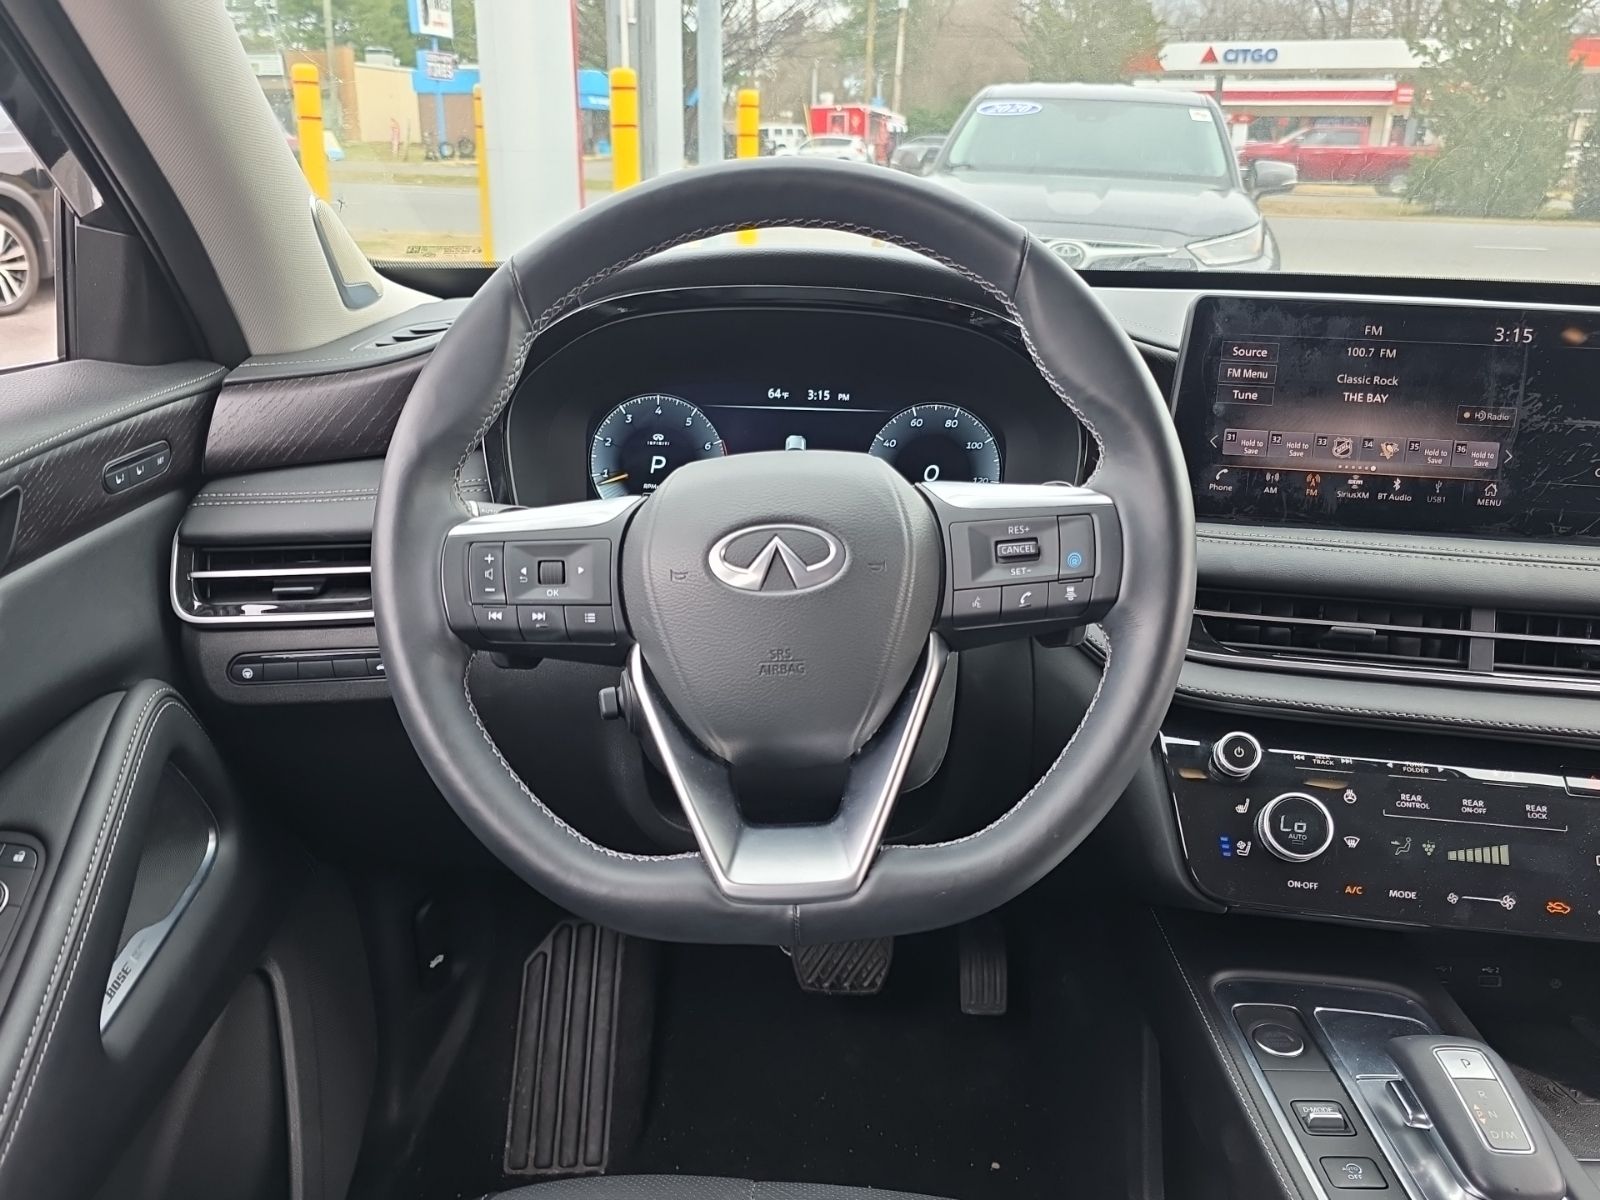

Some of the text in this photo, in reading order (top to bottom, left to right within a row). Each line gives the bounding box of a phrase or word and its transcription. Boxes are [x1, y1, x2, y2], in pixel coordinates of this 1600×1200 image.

[1223, 48, 1278, 63] CITGO
[1364, 326, 1383, 336] FM
[1494, 327, 1534, 343] 3:15
[1232, 346, 1268, 358] Source
[1347, 347, 1397, 359] 100.7 FM
[1227, 368, 1269, 380] FM Menu
[1336, 374, 1399, 386] Classic Rock
[807, 389, 850, 401] 3:15 PM
[1232, 390, 1258, 401] Tune
[1343, 392, 1389, 404] THE BAY
[655, 406, 662, 415] 4
[625, 414, 632, 423] 3
[685, 417, 693, 426] 5
[1487, 413, 1510, 422] Radio
[910, 418, 923, 428] 60
[944, 419, 958, 428] 80
[604, 437, 612, 446] 2
[1226, 433, 1236, 441] 31
[1271, 435, 1281, 443] 32
[1317, 437, 1327, 446] 33
[704, 442, 712, 451] 6
[883, 438, 897, 448] 40
[966, 442, 984, 450] 100
[1241, 439, 1255, 447] Hold
[1363, 440, 1373, 448] 34
[1409, 442, 1420, 451] 35
[1244, 447, 1259, 455] Save
[1288, 449, 1304, 457] Save
[1424, 448, 1448, 457] Hold to
[1456, 445, 1466, 453] 36
[1471, 451, 1486, 459] Hold
[650, 455, 666, 474] P
[1427, 456, 1443, 464] Save
[1473, 459, 1489, 467] Save
[602, 468, 609, 477] 1
[1208, 483, 1233, 492] Phone
[1336, 490, 1370, 499] SiriusXM
[1377, 492, 1412, 502] BT Audio
[1426, 495, 1446, 503] USB1
[1476, 498, 1502, 507] MENU
[1008, 526, 1030, 535] RES+
[1001, 544, 1036, 555] CANCEL
[546, 589, 560, 597] OK
[769, 648, 792, 661] SRS
[758, 663, 806, 677] AIRBAG
[1312, 758, 1335, 766] TRACK
[1402, 766, 1429, 774] FOLDER
[1400, 793, 1422, 802] REAR
[1396, 801, 1430, 810] CONTROL
[1462, 799, 1484, 808] REAR
[1461, 806, 1487, 815] ON-OFF
[1525, 804, 1548, 813] REAR
[1527, 812, 1548, 820] LOCK
[1280, 814, 1307, 833] Lo
[1288, 833, 1308, 841] AUTO
[1287, 879, 1319, 890] ON-OFF
[1345, 885, 1363, 895] A/C
[1388, 889, 1417, 900] MODE
[105, 961, 132, 1005] BOSE
[1460, 1058, 1471, 1069] P
[1477, 1090, 1487, 1098] R
[1302, 1106, 1333, 1114] D-MODE
[1488, 1110, 1498, 1119] N
[1490, 1130, 1517, 1140] D/M
